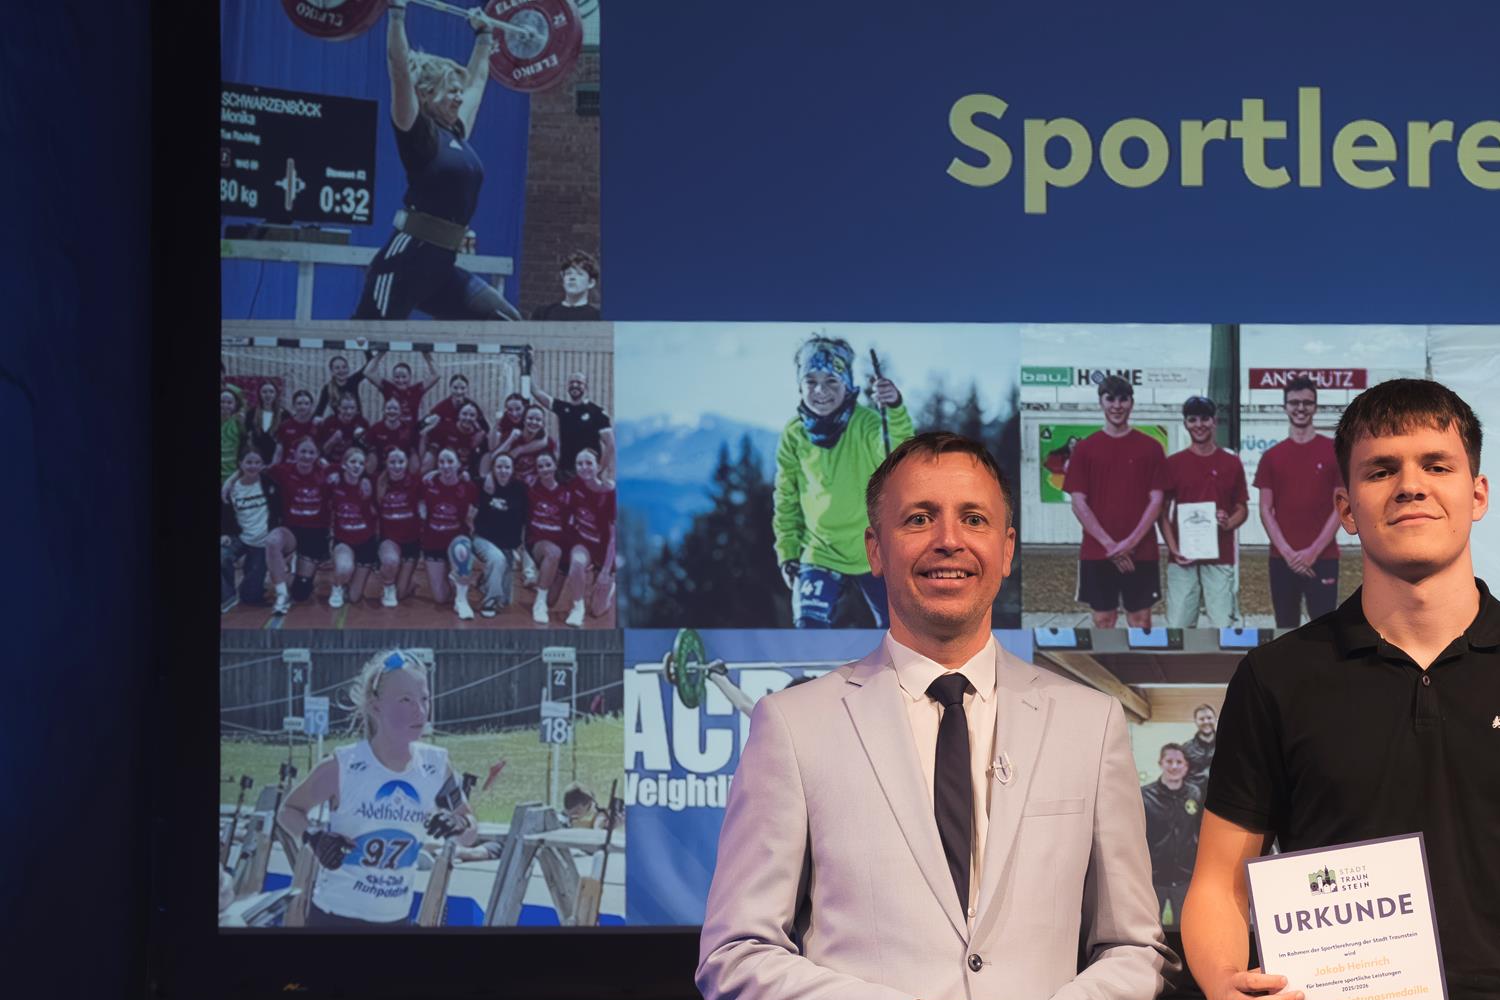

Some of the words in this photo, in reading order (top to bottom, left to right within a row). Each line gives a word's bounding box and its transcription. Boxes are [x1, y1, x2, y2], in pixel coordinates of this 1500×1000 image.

[241, 185, 258, 208] kg
[319, 184, 370, 215] 0:32
[554, 670, 567, 686] 22
[306, 711, 328, 733] 19
[542, 718, 568, 744] 18
[362, 838, 411, 869] 97
[1338, 865, 1367, 875] STADT
[1340, 873, 1368, 884] TRAUN
[1341, 882, 1370, 892] STEIN
[1274, 893, 1414, 935] URKUNDE
[1389, 931, 1418, 940] Traunstein
[1314, 962, 1345, 977] Jakob
[1347, 956, 1390, 971] Heinrich
[1316, 979, 1343, 988] besondere
[1372, 970, 1402, 979] Leistungen
